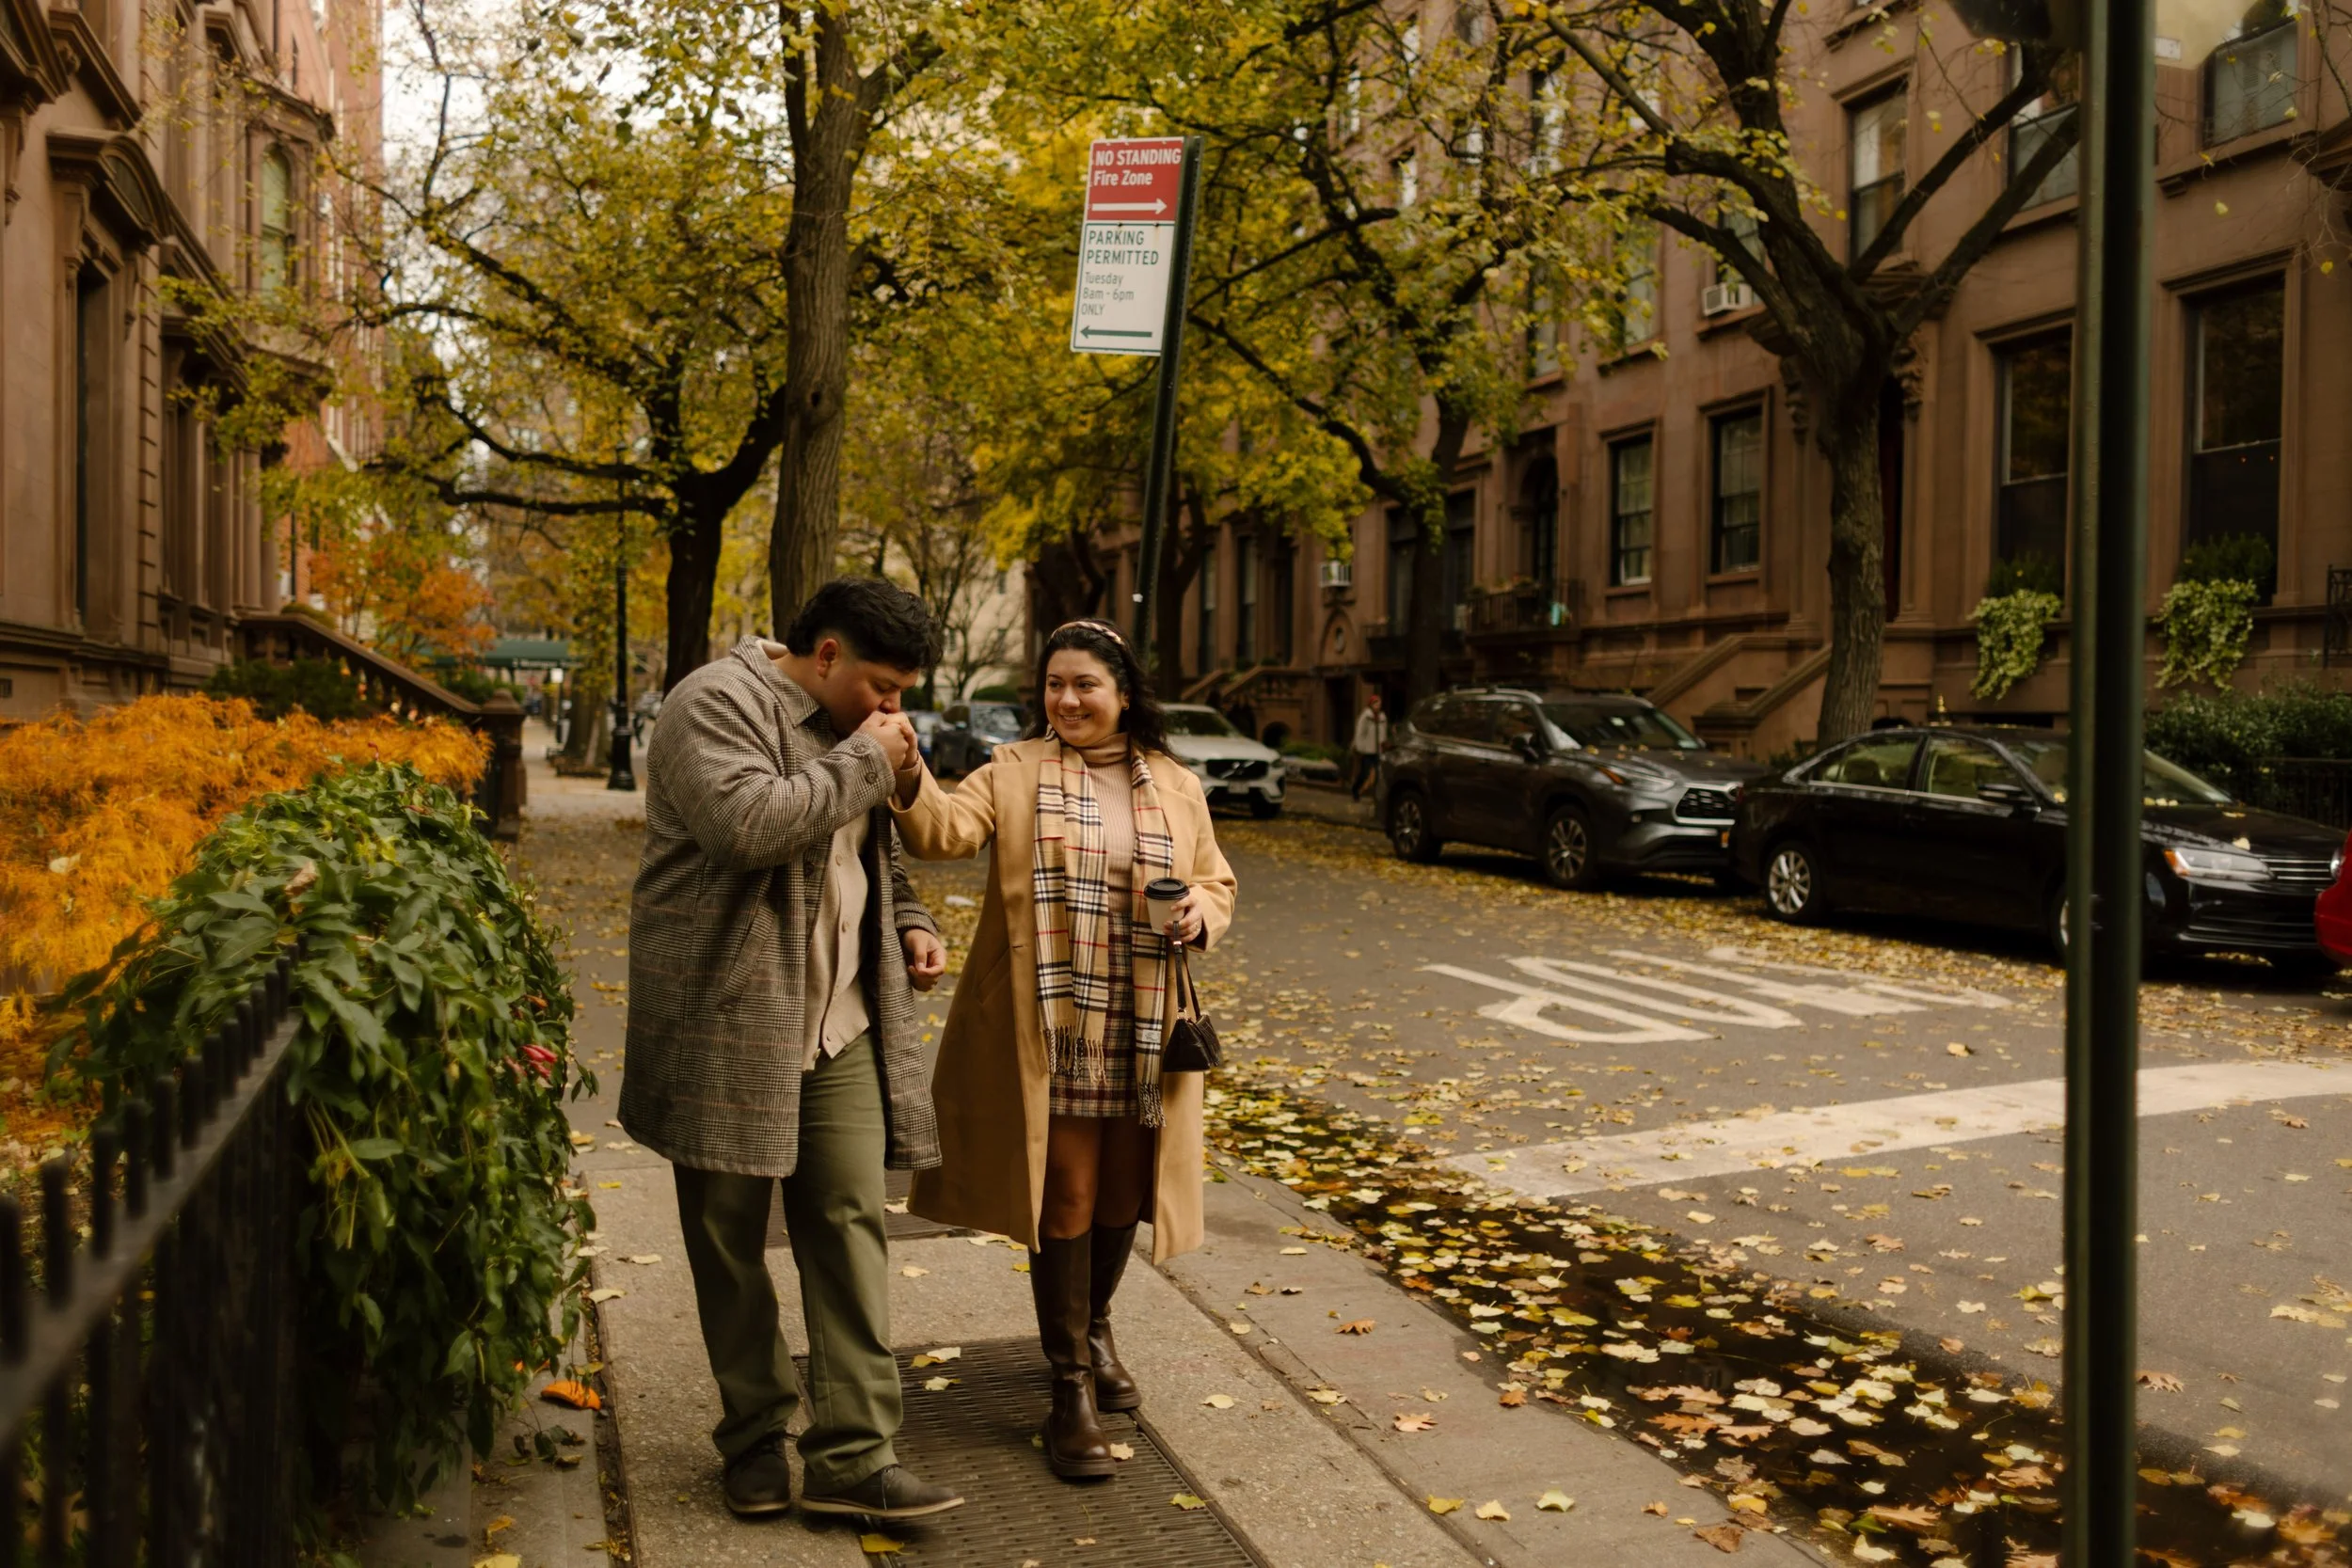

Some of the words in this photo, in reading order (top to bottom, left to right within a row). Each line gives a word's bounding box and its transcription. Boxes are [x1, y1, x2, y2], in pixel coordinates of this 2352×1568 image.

[1096, 150, 1114, 166] NO
[1117, 149, 1182, 166] STANDING
[1094, 170, 1119, 186] Fire
[1121, 170, 1153, 186] Zone
[1088, 230, 1145, 245] PARKING
[1086, 250, 1159, 265] PERMITTED
[1085, 272, 1123, 286] Tuesday
[1082, 288, 1104, 300] 8am
[1112, 288, 1135, 302] 6pm
[1081, 304, 1105, 316] ONLY
[1423, 946, 2012, 1043] STOP
